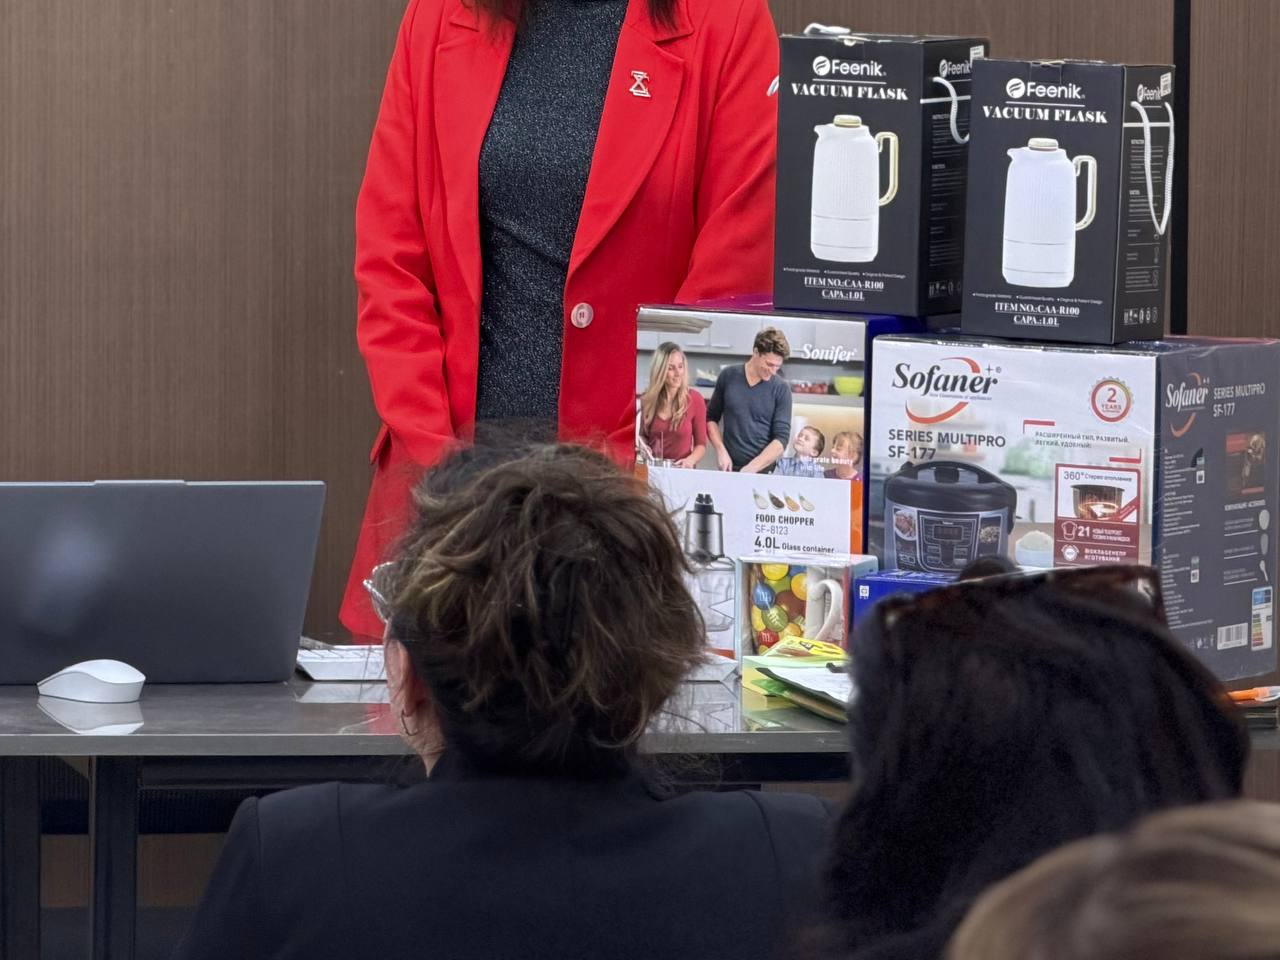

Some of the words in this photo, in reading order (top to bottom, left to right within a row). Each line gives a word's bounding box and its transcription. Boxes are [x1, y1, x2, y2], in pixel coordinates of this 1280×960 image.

[831, 59, 883, 76] Feenik
[791, 83, 854, 98] VACUUM
[857, 86, 908, 100] FLASK
[1026, 82, 1082, 99] Feenik
[982, 106, 1050, 121] VACUUM
[1054, 109, 1108, 123] FLASK
[801, 343, 855, 364] Sonifer
[892, 363, 998, 396] Sofaner
[1106, 387, 1117, 403] 2
[1165, 382, 1209, 412] Sofaner
[1213, 386, 1234, 400] SERIES
[1213, 402, 1236, 417] SF-177
[888, 428, 933, 443] SERIES
[937, 432, 1006, 447] MULTIPRO
[888, 445, 936, 460] SF-177
[755, 513, 776, 523] FOOD
[778, 515, 815, 526] CHOPPER
[754, 524, 789, 536] SF-8123
[1077, 525, 1090, 537] 21
[754, 536, 780, 550] 4.0L
[781, 542, 801, 551] Glass
[802, 545, 835, 554] container
